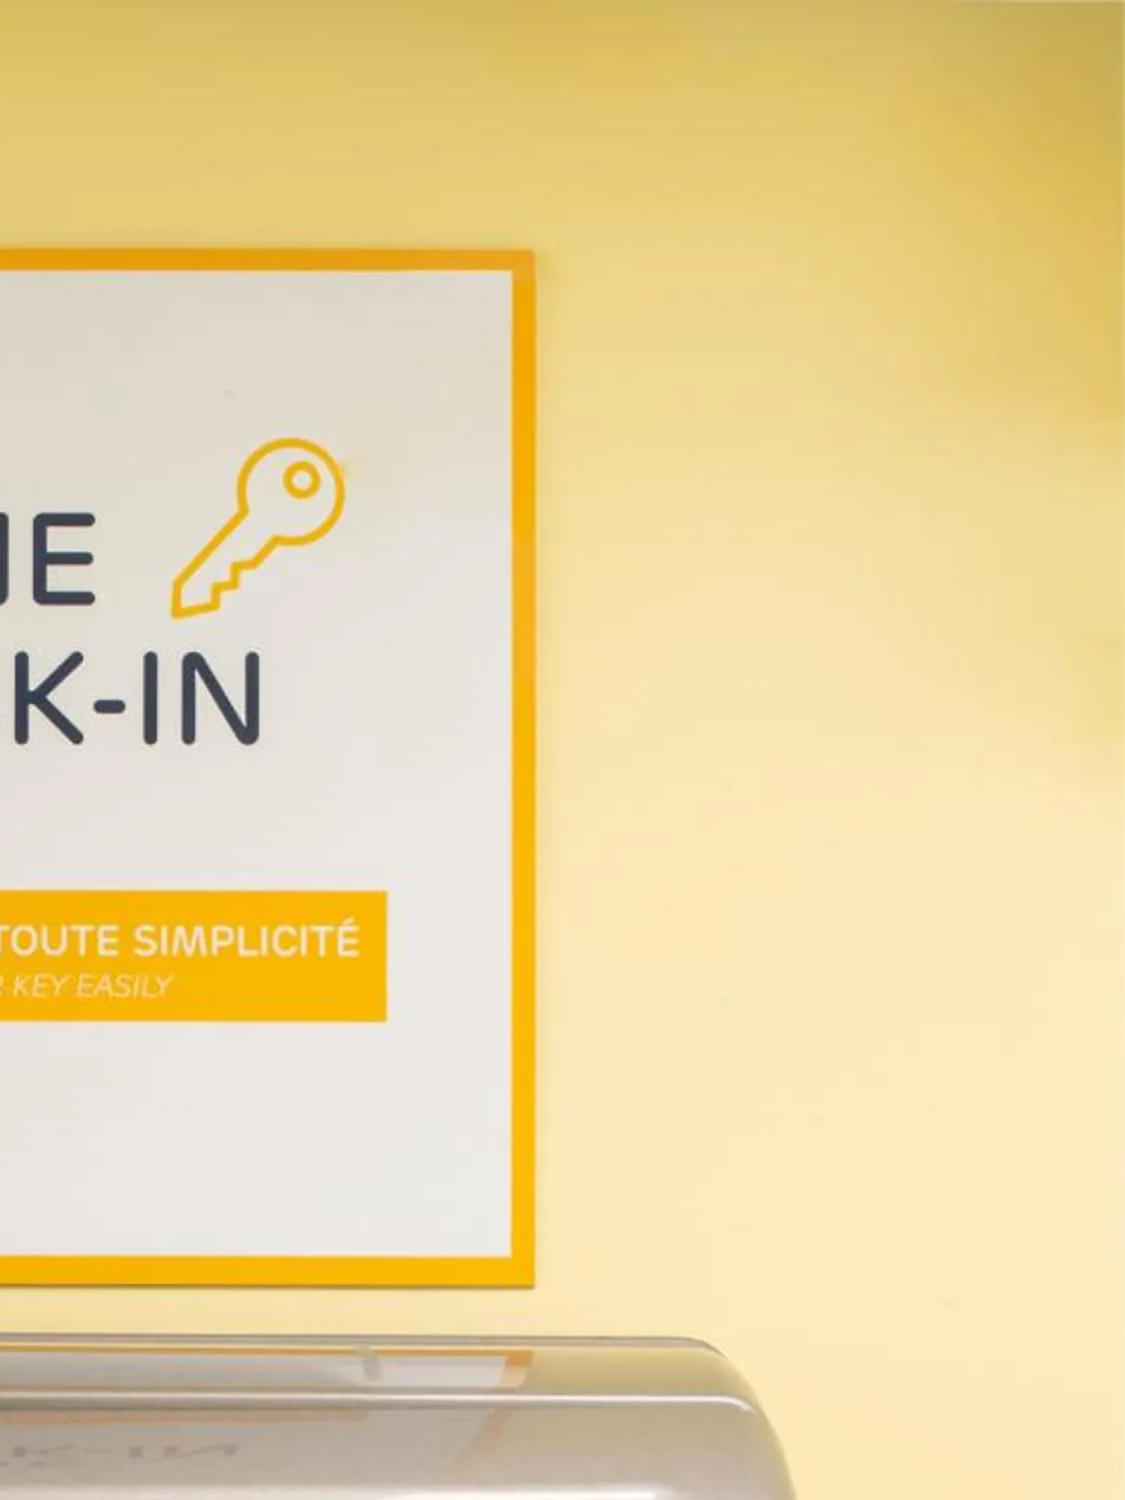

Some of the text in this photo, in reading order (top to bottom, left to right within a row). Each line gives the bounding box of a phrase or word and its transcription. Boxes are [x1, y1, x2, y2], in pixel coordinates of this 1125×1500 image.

[135, 917, 359, 957] SIMPLICITÉ
[12, 972, 70, 999] KEY
[75, 972, 175, 999] EASILY
